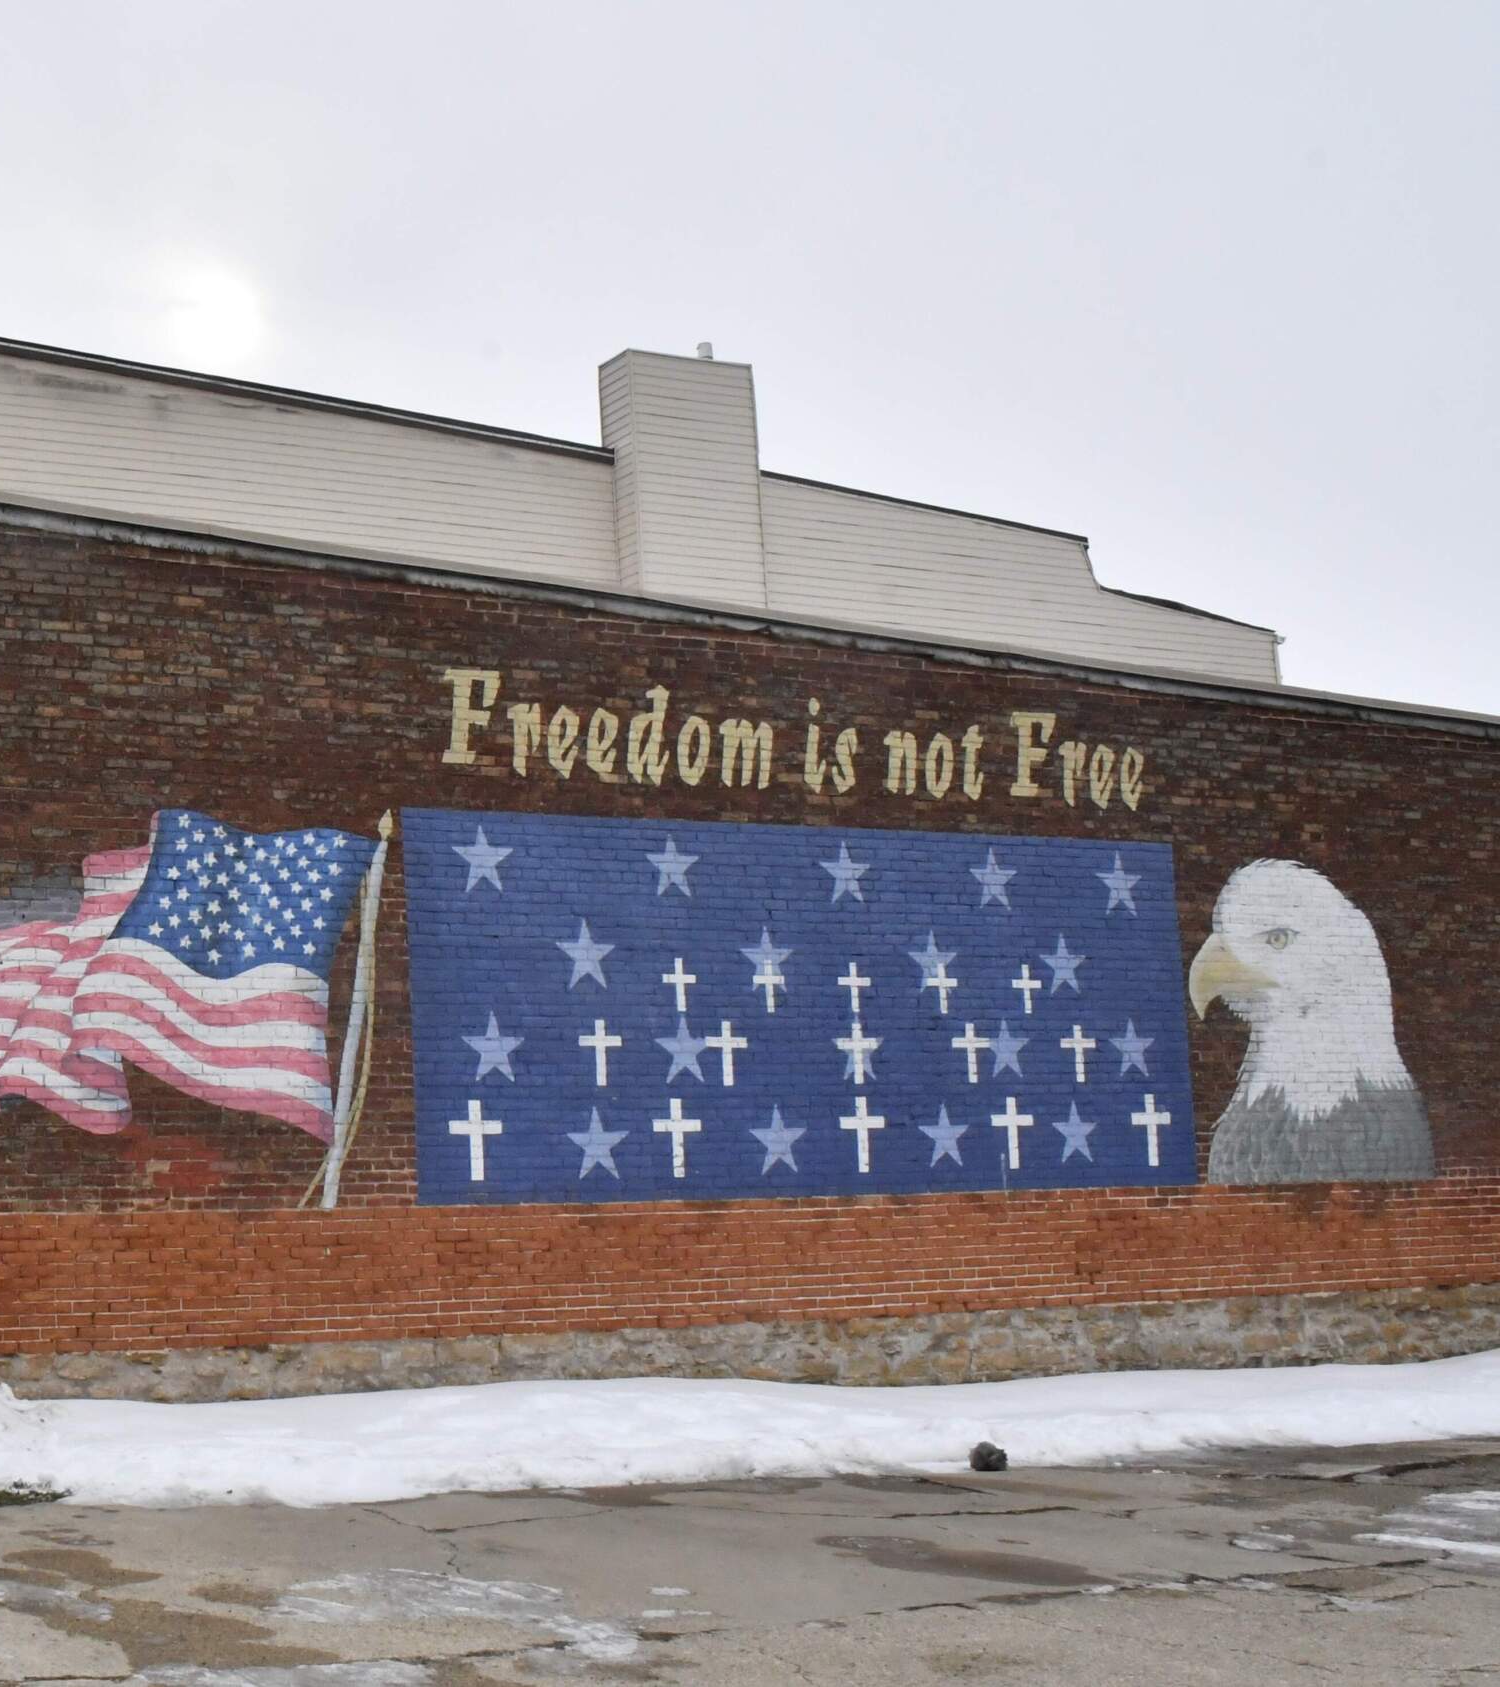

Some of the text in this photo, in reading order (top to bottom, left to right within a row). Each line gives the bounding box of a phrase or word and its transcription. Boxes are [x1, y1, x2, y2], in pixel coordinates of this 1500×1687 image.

[441, 668, 1145, 812] Freedom is not Free
